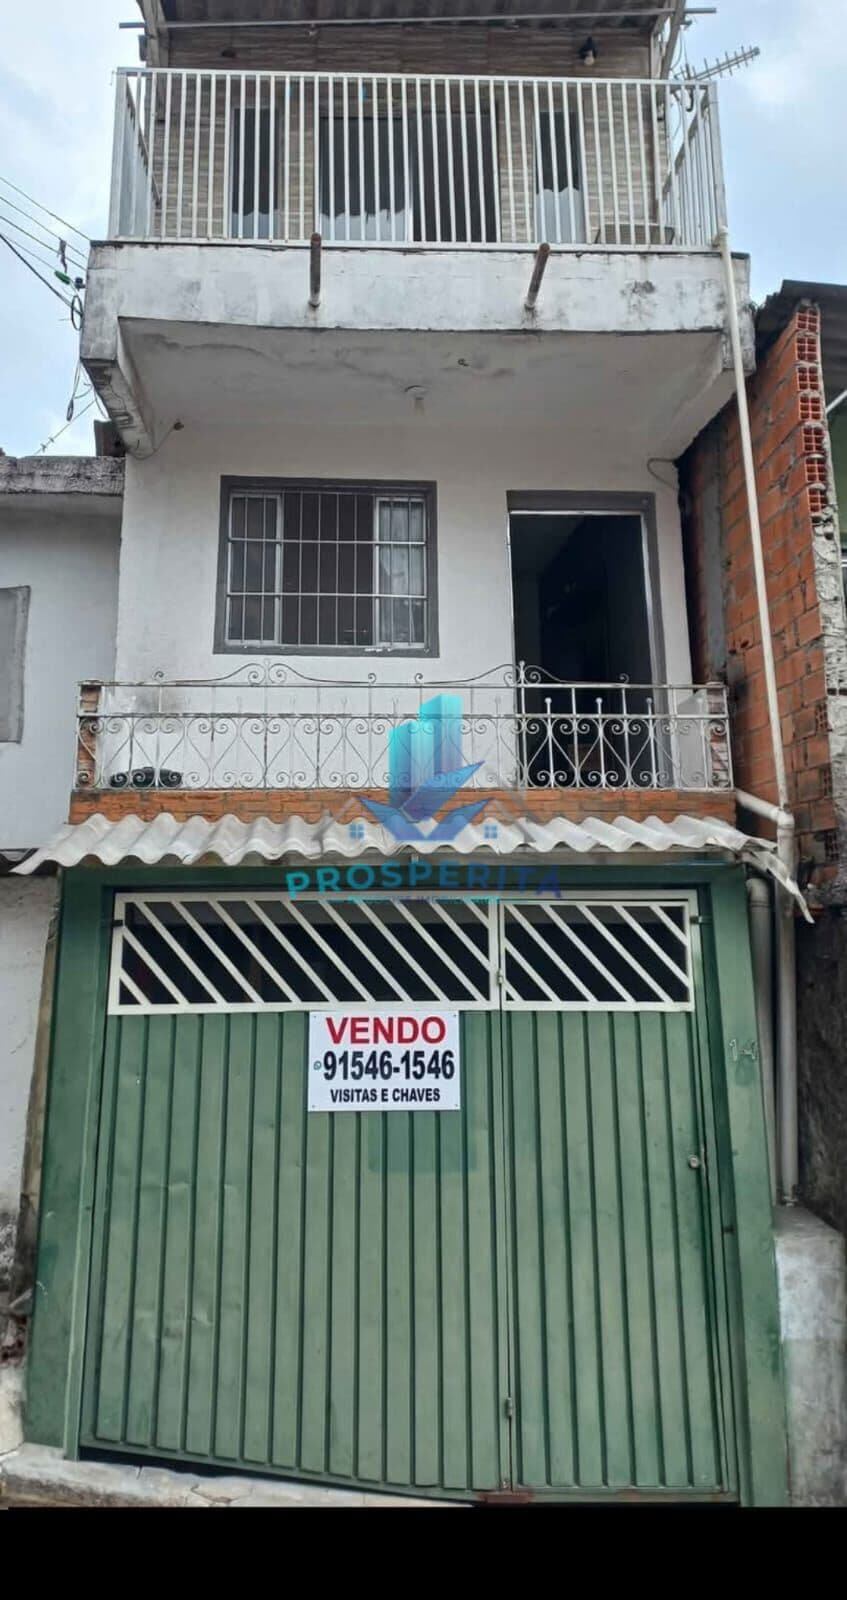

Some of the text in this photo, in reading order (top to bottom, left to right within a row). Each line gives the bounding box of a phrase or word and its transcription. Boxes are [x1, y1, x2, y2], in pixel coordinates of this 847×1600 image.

[325, 1016, 446, 1045] VENDO
[323, 1050, 455, 1081] 91546-1546
[330, 1088, 441, 1103] VISITAS E CHAVES
